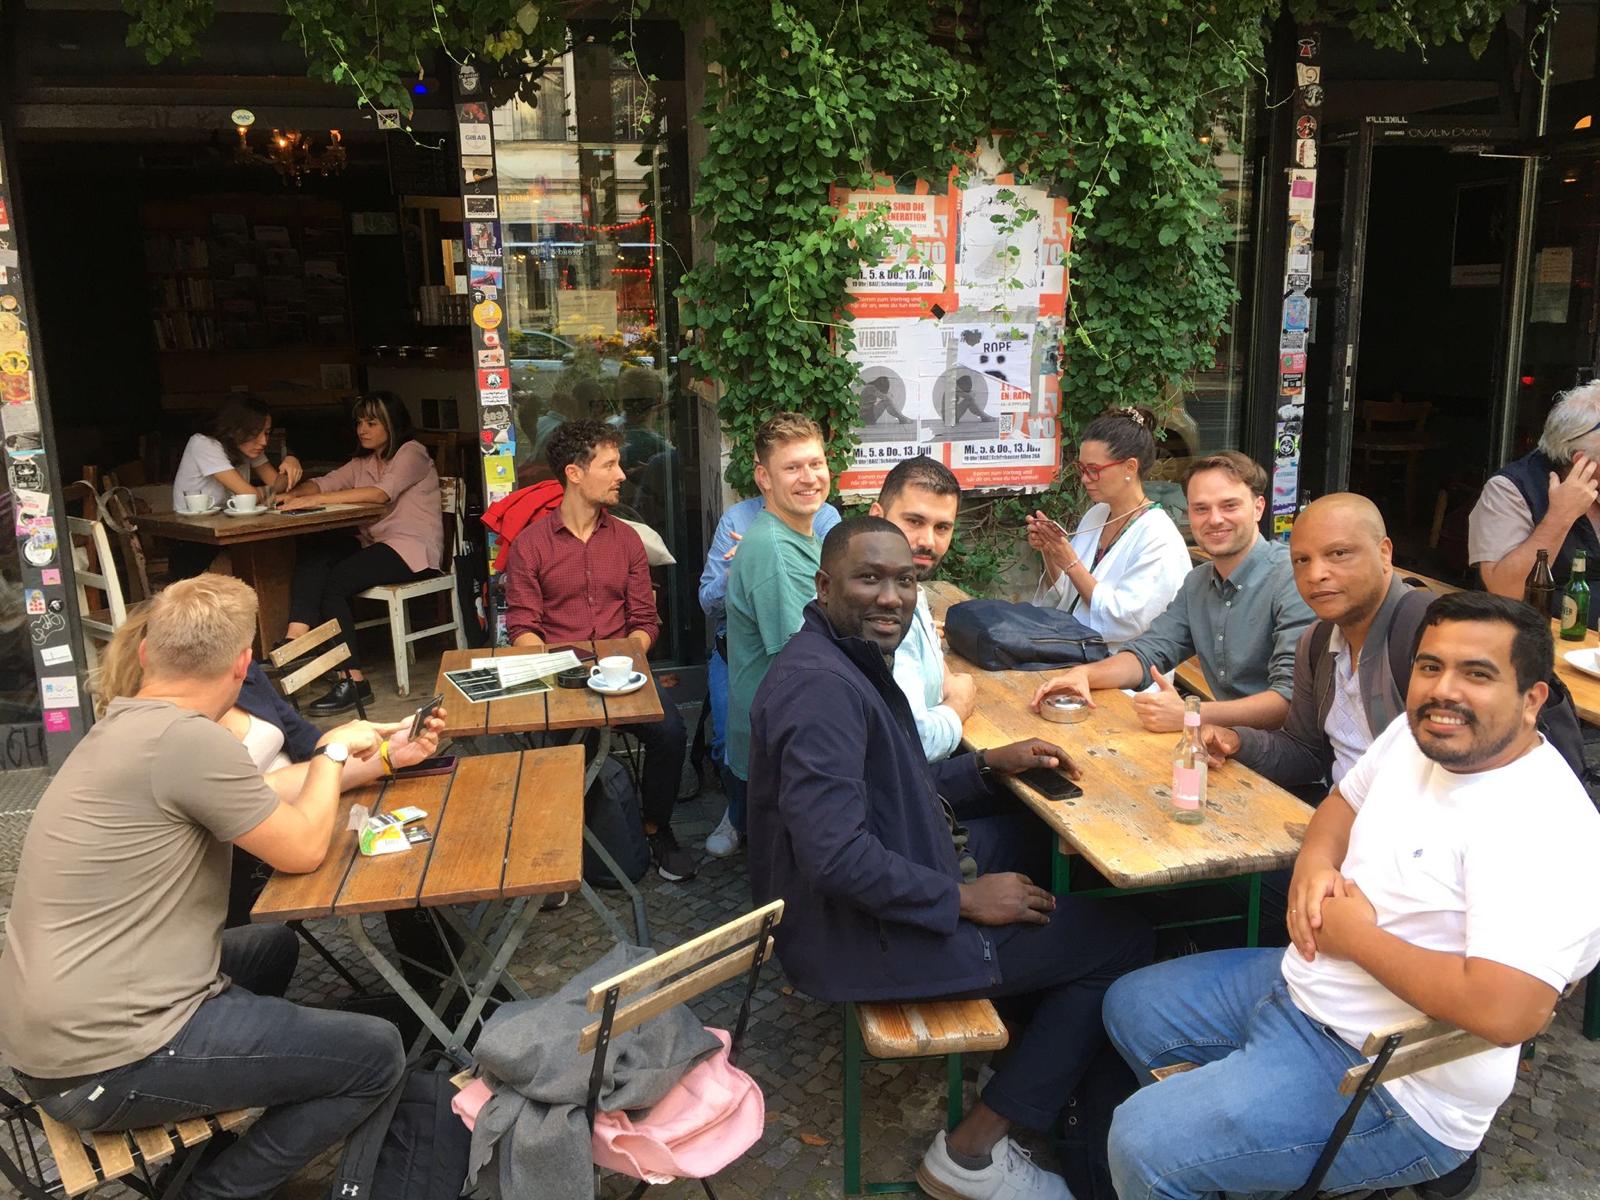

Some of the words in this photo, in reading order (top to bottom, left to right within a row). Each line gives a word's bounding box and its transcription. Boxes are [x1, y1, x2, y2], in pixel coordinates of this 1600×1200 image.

[893, 202, 911, 211] SIND
[912, 202, 925, 211] DIE
[883, 213, 927, 221] ENERATION
[879, 270, 885, 280] &
[868, 447, 877, 457] 5.
[878, 448, 885, 457] &
[903, 445, 915, 456] 13.
[916, 445, 932, 456] Juli
[989, 445, 995, 454] &
[1014, 443, 1025, 453] 13.
[1026, 443, 1041, 452] Ju
